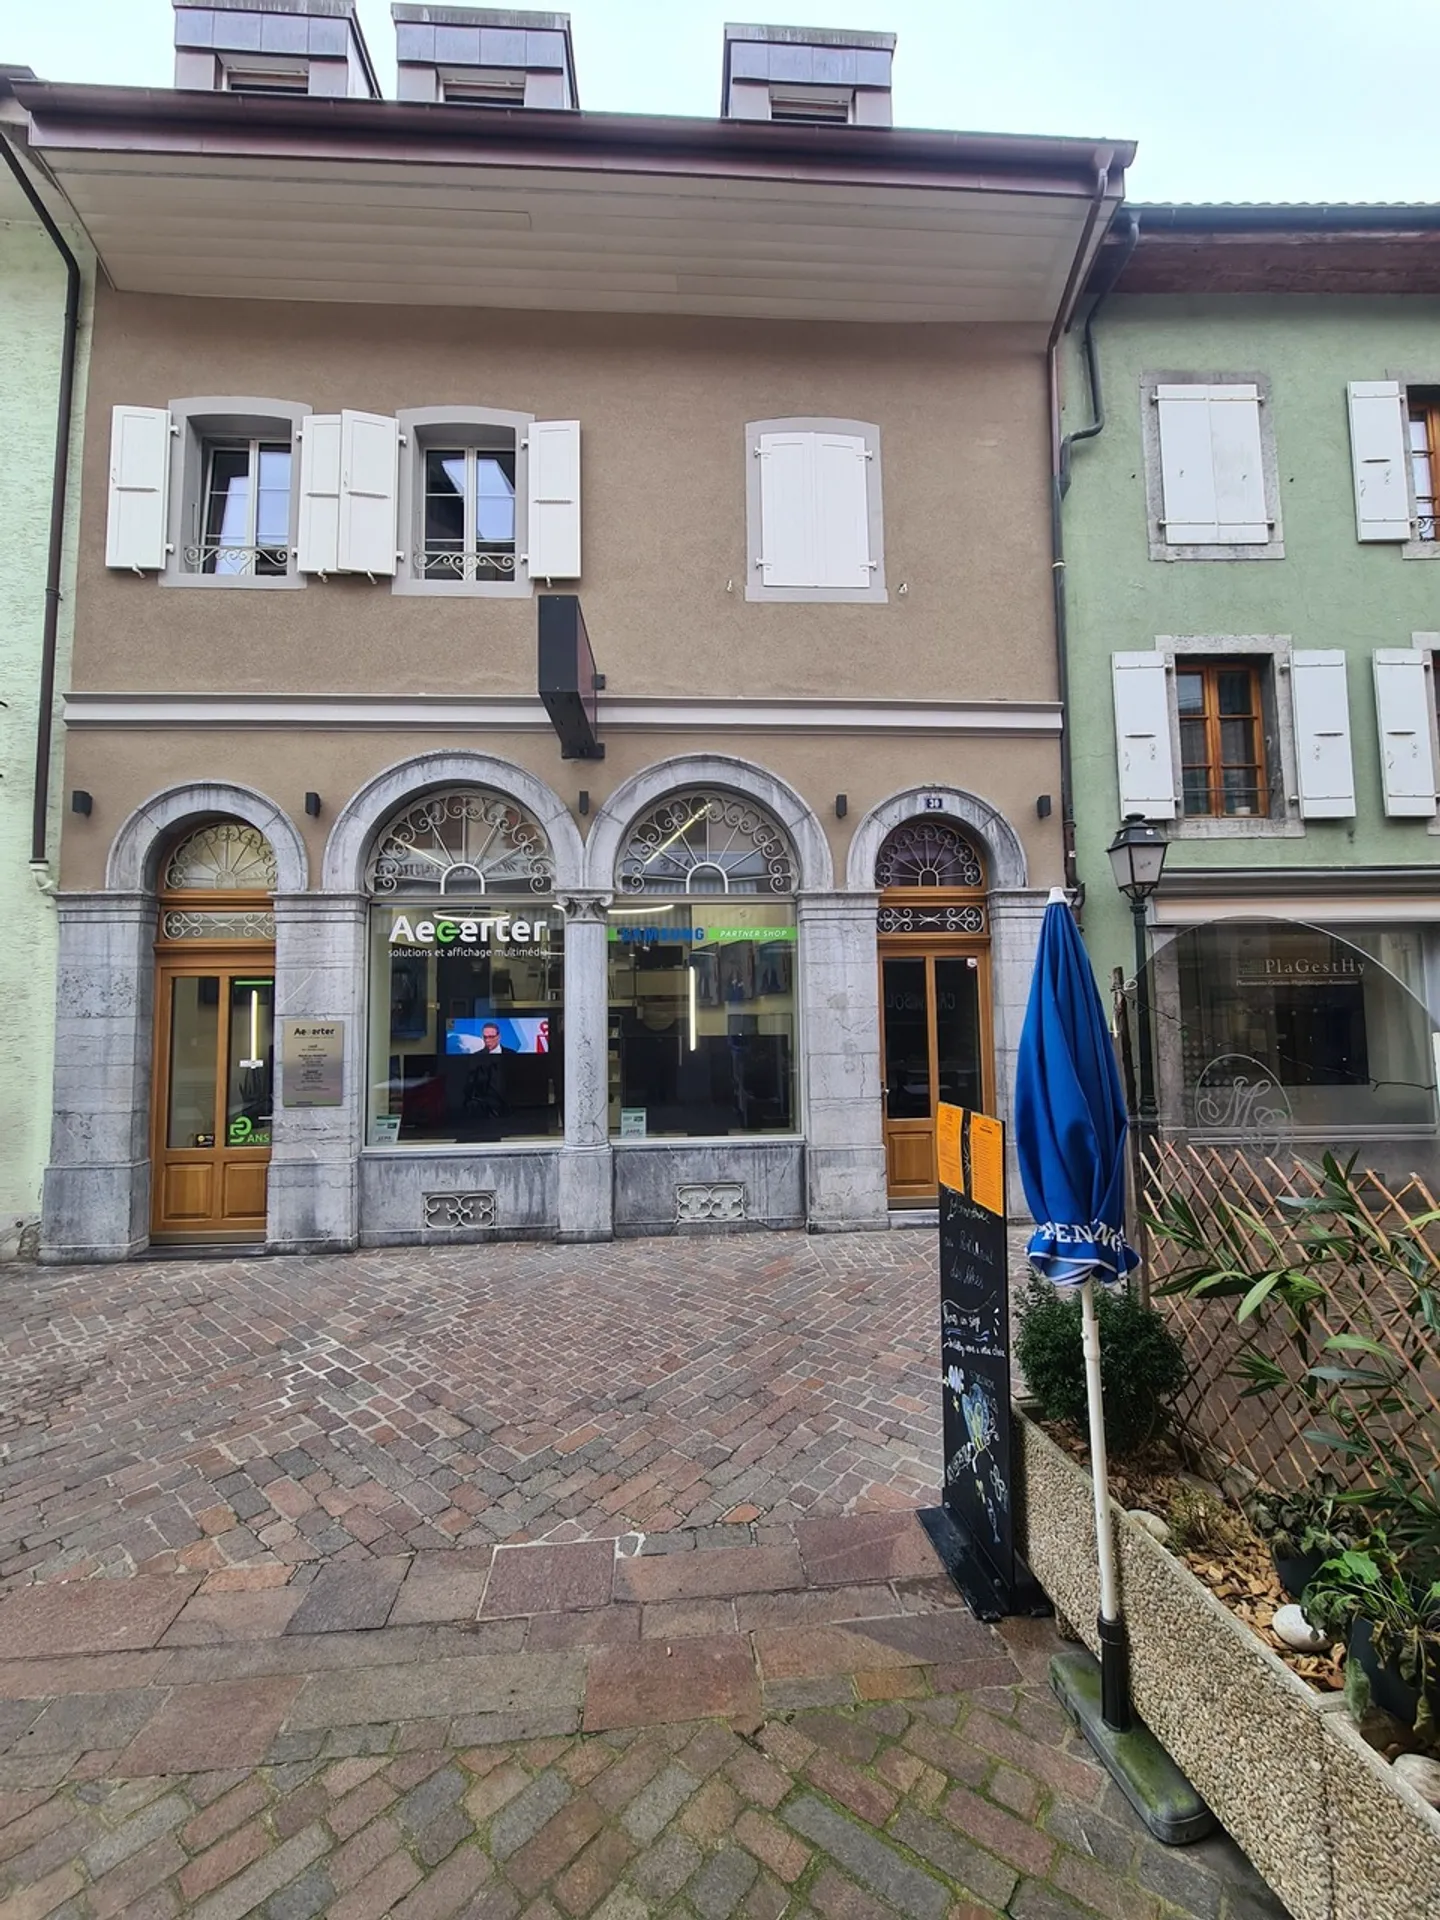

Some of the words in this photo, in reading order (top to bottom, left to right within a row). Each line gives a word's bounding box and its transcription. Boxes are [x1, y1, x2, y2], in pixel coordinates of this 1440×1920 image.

[719, 930, 759, 938] PARTNER
[763, 930, 788, 938] SHOP
[388, 947, 432, 957] solutions
[435, 948, 445, 957] et
[447, 947, 491, 959] affichage
[1265, 958, 1365, 975] PlaGestHy
[247, 1133, 270, 1142] ANS
